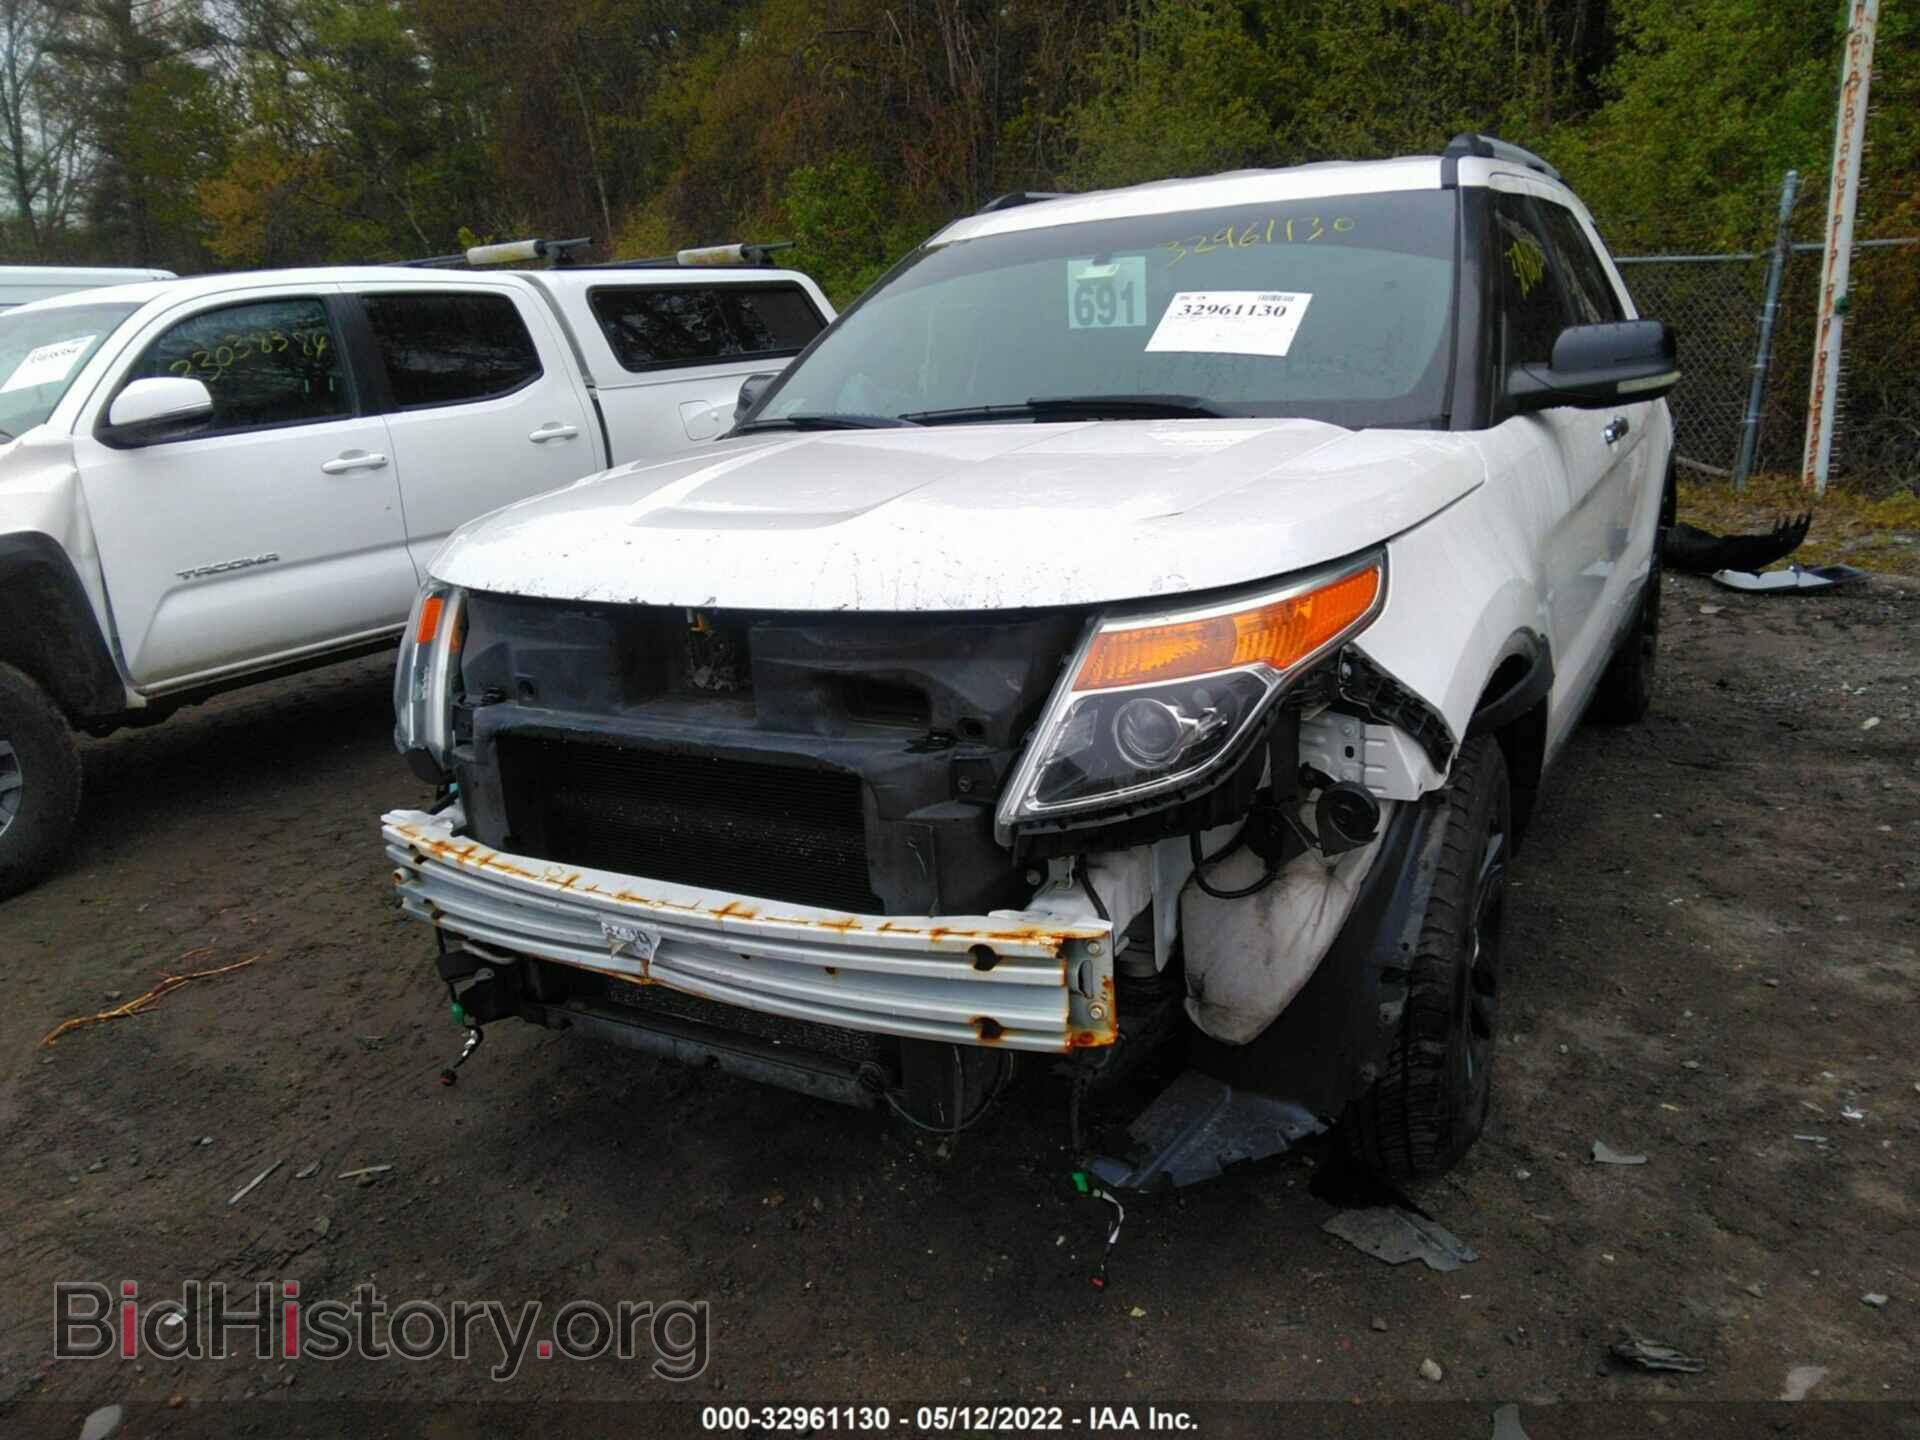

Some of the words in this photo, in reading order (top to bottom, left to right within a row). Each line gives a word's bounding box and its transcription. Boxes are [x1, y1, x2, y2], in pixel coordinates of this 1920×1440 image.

[1167, 215, 1355, 268] 32961130
[1074, 279, 1136, 325] 691
[1177, 303, 1288, 318] 32961130
